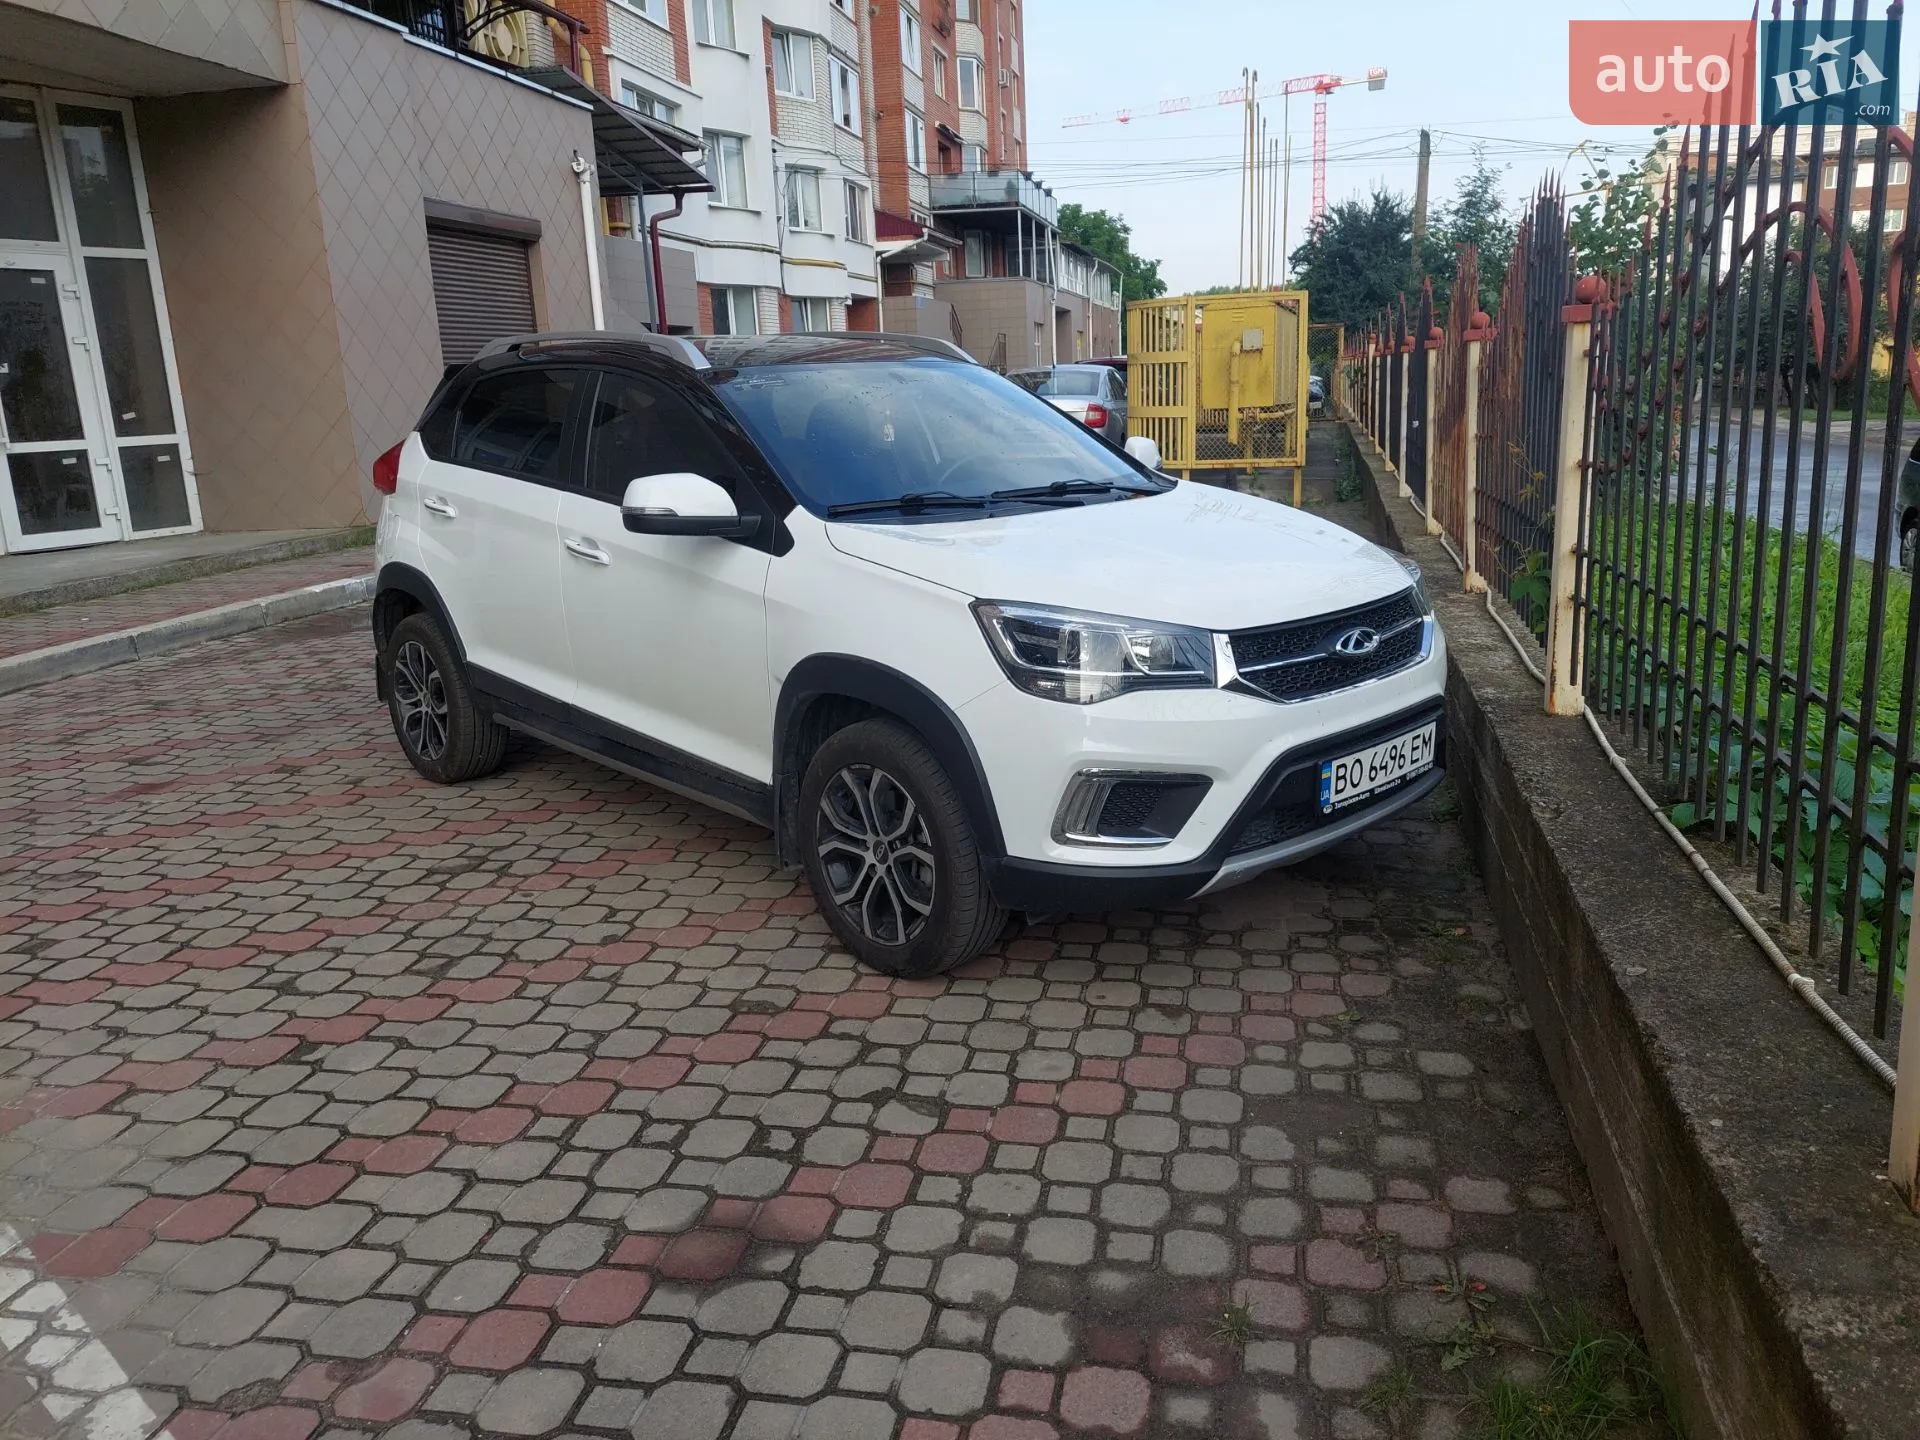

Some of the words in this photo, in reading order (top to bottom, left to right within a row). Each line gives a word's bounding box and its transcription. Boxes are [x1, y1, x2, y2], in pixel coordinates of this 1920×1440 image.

[1335, 758, 1363, 795] BO
[1368, 740, 1406, 782] 6496
[1410, 728, 1433, 764] EM
[1320, 789, 1330, 801] UA
